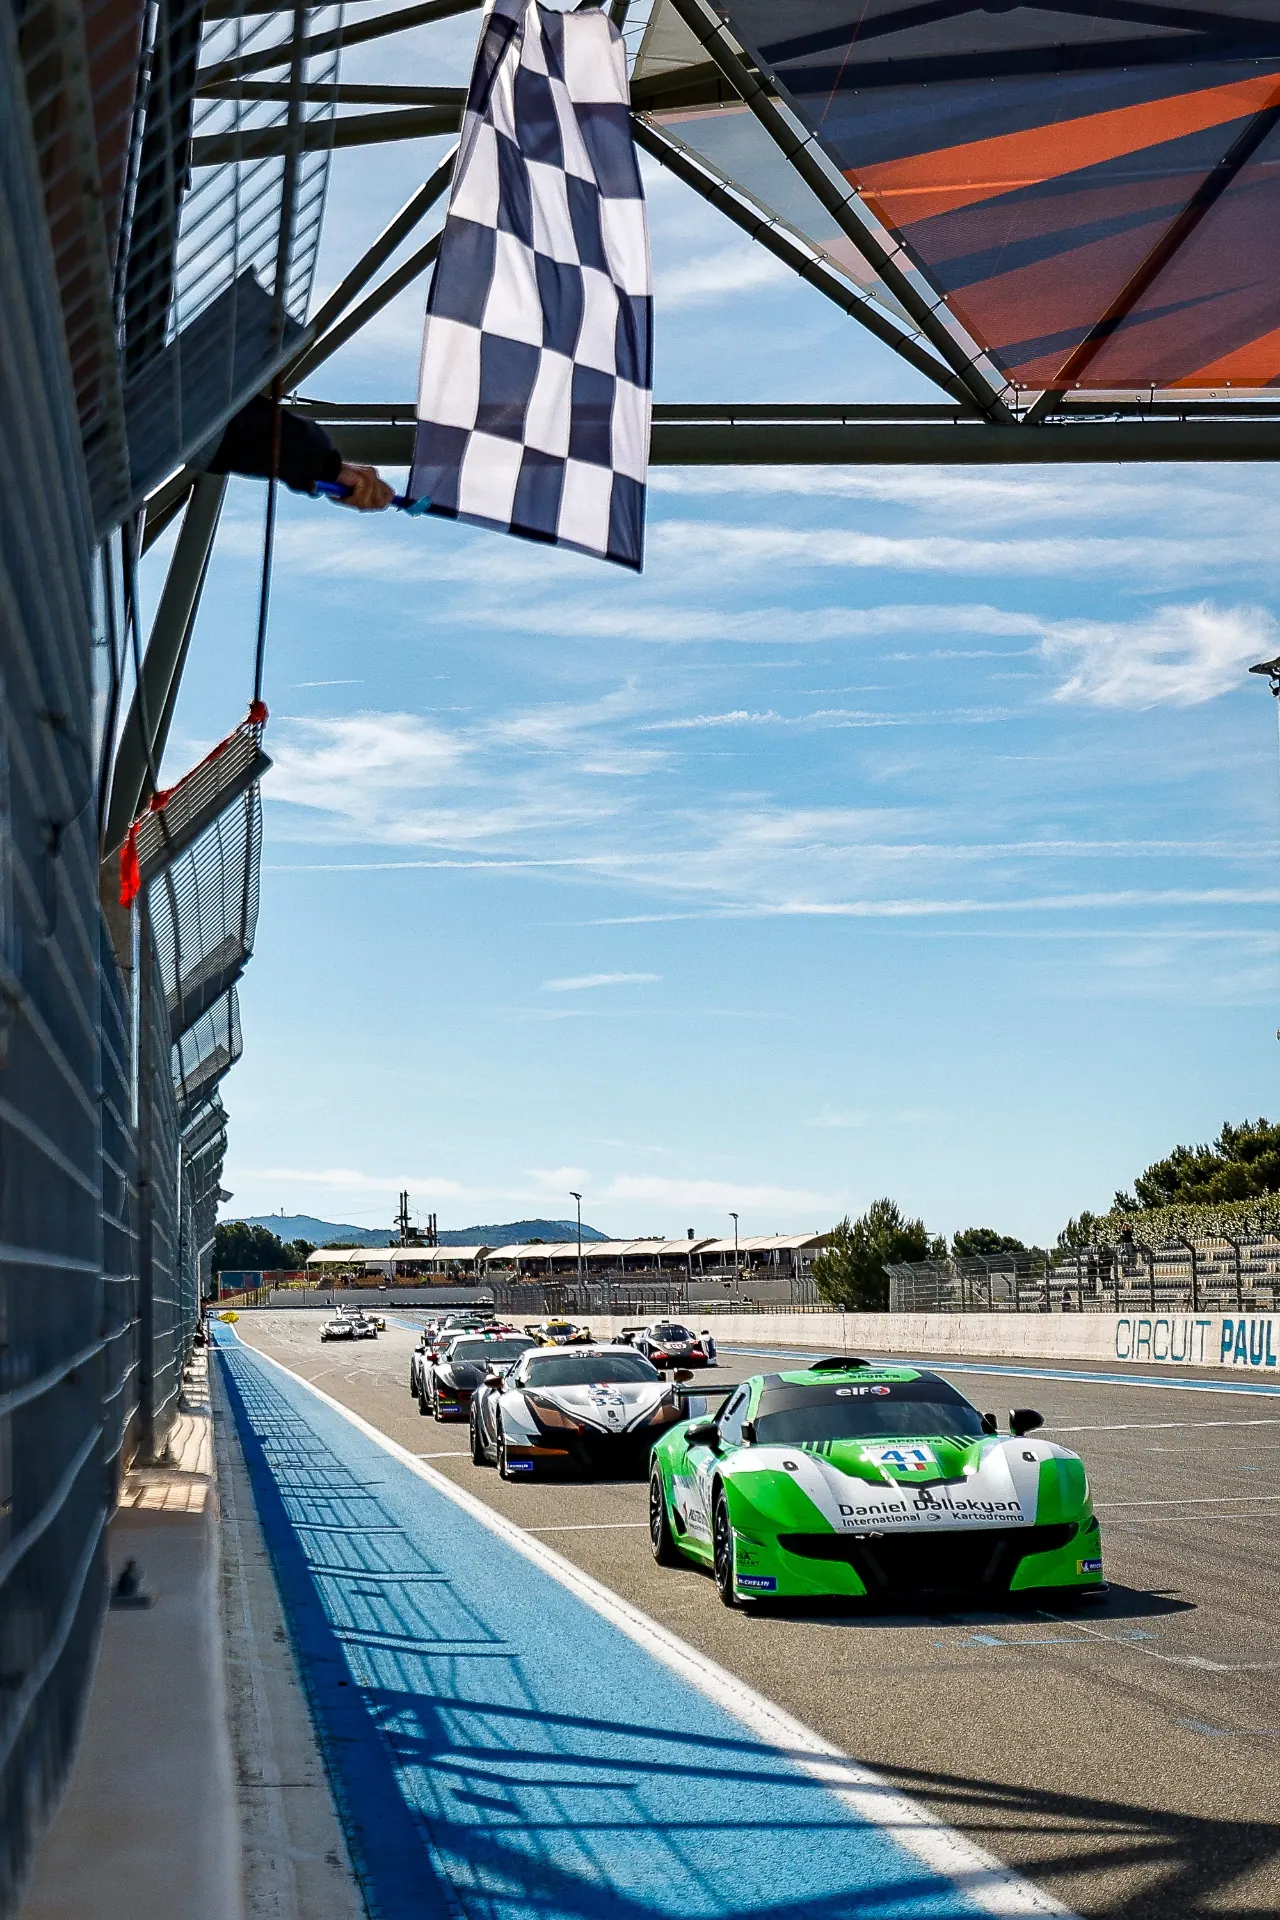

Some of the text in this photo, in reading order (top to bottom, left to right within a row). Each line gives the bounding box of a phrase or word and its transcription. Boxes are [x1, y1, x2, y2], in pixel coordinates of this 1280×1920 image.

[1115, 1319, 1277, 1367] CIRCUIT PAUL
[835, 1386, 869, 1397] elf
[591, 1397, 625, 1407] 33
[880, 1449, 928, 1463] 41
[838, 1499, 1022, 1517] Daniel Dallakyan
[842, 1512, 1025, 1527] International Kartodromo
